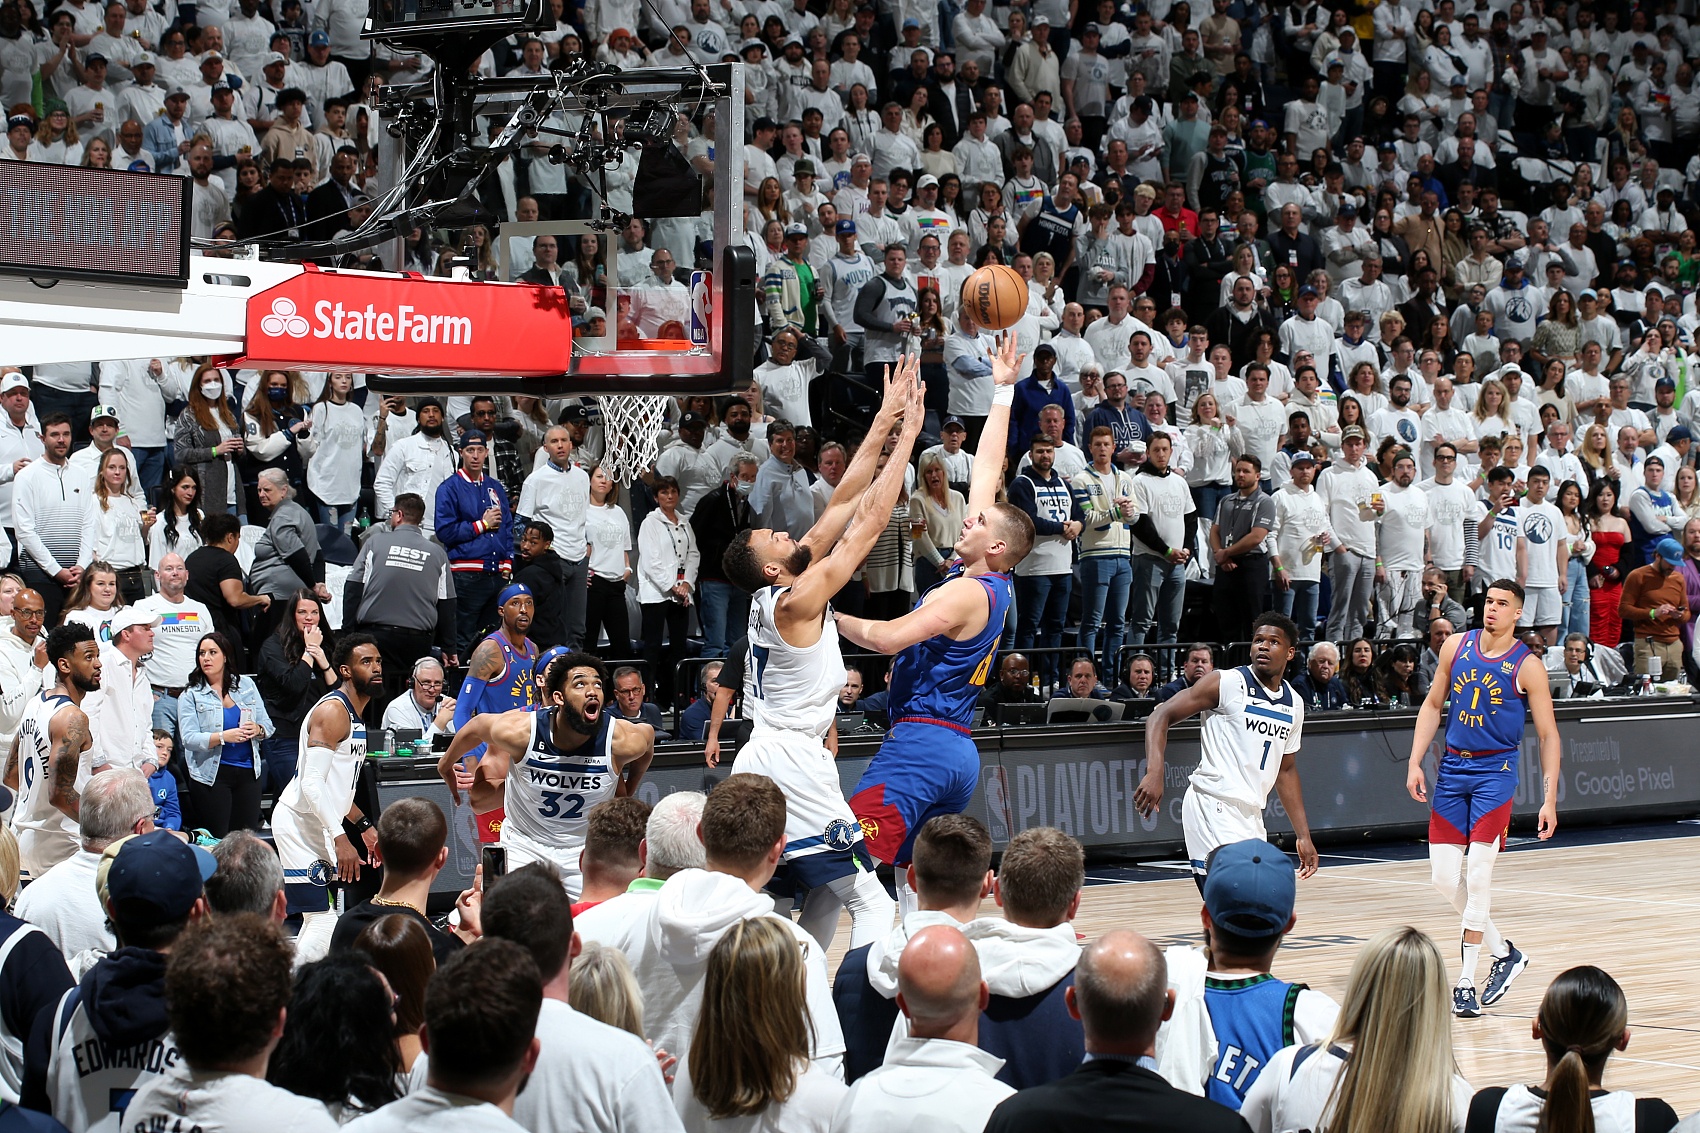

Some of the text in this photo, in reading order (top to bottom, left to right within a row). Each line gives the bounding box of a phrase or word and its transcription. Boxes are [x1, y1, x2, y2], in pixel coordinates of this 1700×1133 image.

[6, 187, 171, 251] THE NBA APP
[1038, 219, 1069, 237] MINNESOTA
[842, 270, 871, 285] WOLVE
[979, 282, 991, 324] Wilson
[313, 299, 472, 345] State Farm
[693, 328, 705, 340] NBA
[1111, 422, 1142, 440] MB
[1496, 532, 1513, 550] 10
[389, 545, 430, 561] BEST
[161, 625, 201, 634] MINNESOTA
[510, 669, 528, 697] MILE
[1453, 668, 1503, 705] MILE HIGH
[1470, 687, 1480, 710] 1
[1245, 717, 1291, 741] WOLVES
[1458, 710, 1484, 728] CITY
[538, 740, 545, 750] 6
[1259, 740, 1272, 770] 1
[1569, 737, 1611, 764] Presented
[529, 769, 602, 790] WOLVES
[1574, 764, 1676, 800] Google Pixel
[538, 790, 586, 819] 32
[71, 1037, 180, 1079] EDWARDS
